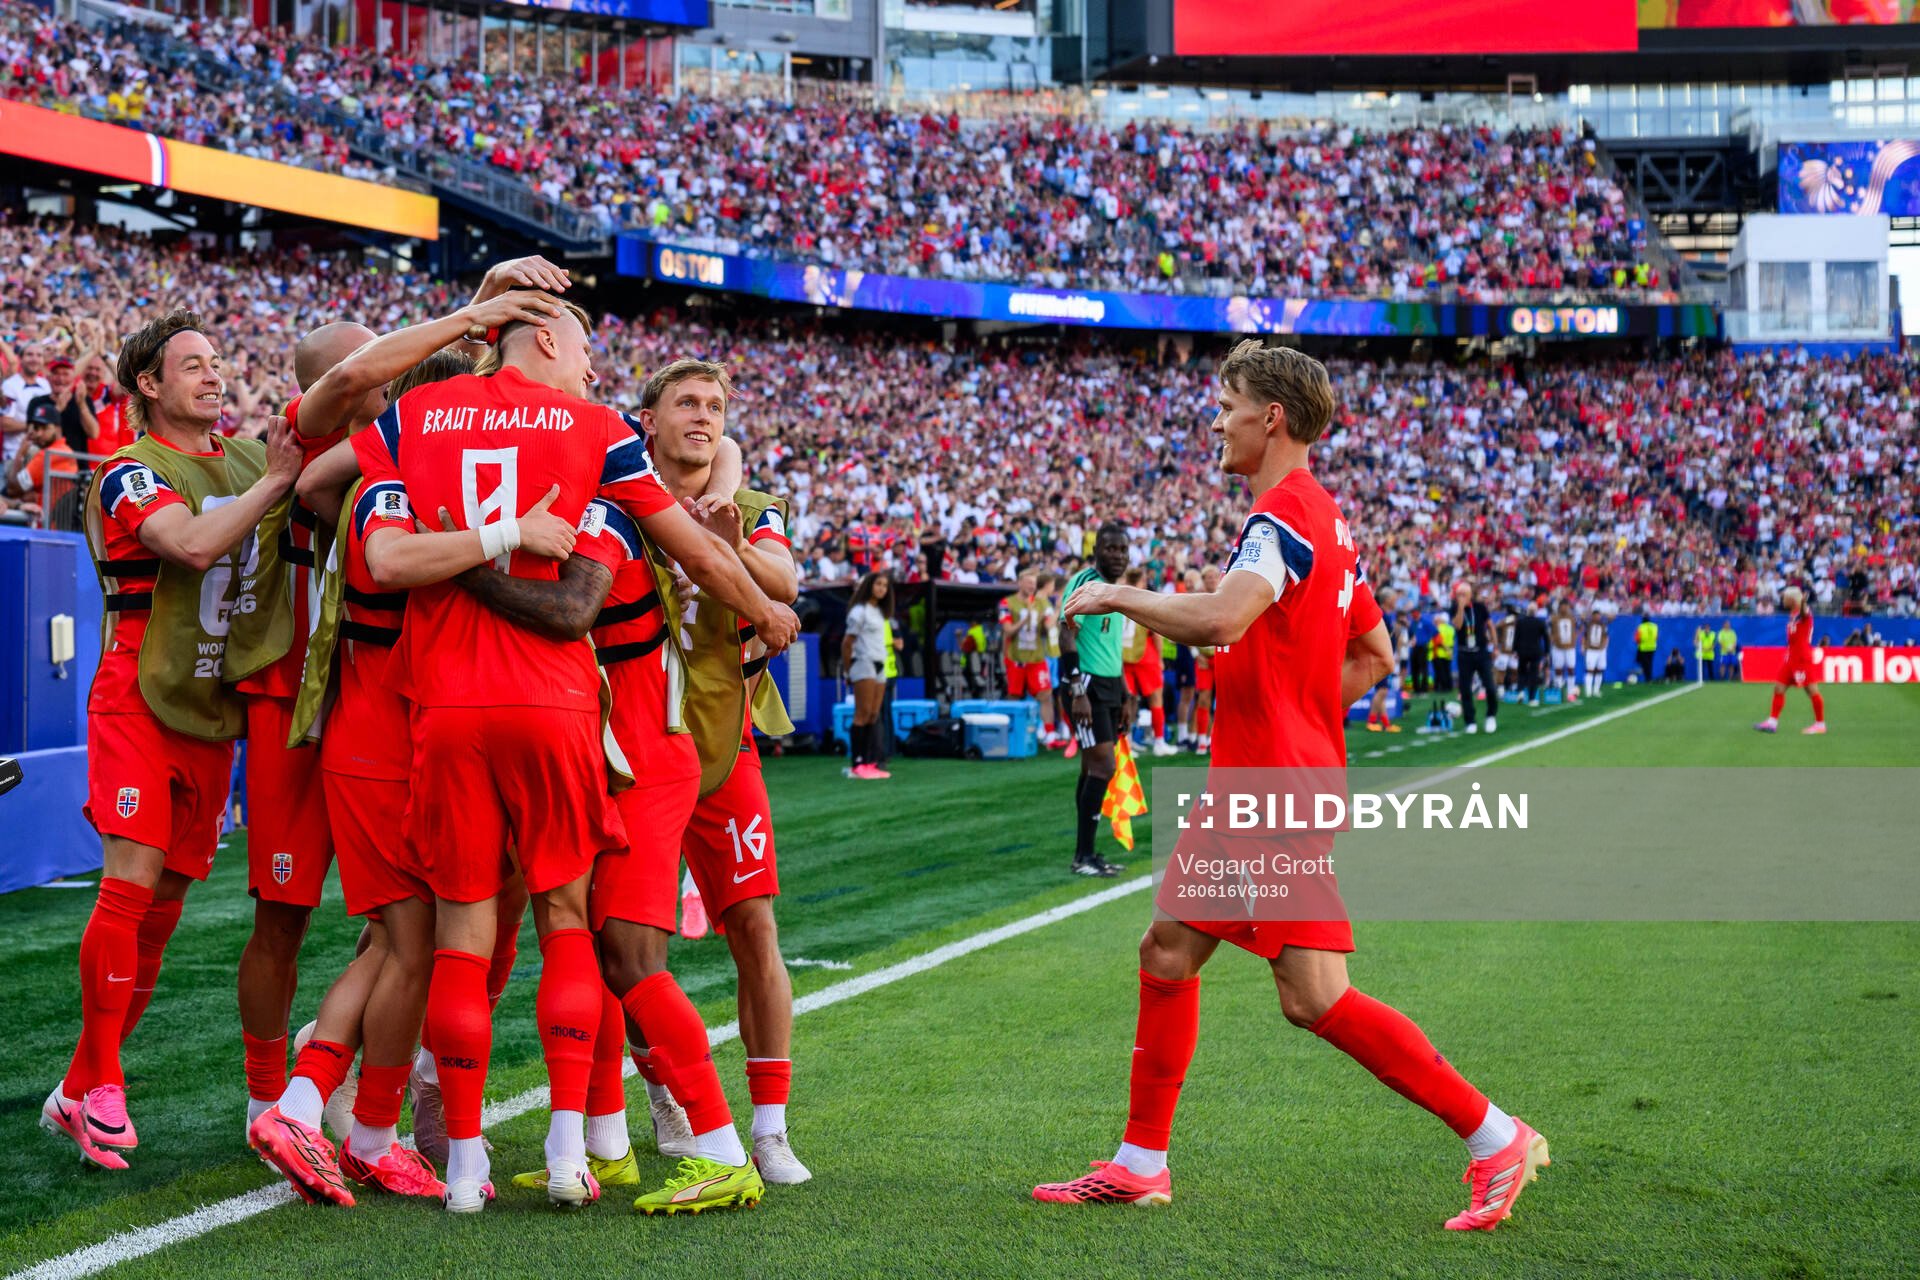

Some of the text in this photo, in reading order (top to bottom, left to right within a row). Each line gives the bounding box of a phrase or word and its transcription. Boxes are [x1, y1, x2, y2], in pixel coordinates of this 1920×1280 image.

[660, 248, 724, 285] OSTON
[1512, 307, 1618, 333] OSTON
[422, 407, 574, 435] BRAUT HAALAND
[461, 446, 519, 576] 9
[1812, 647, 1864, 683] 'm
[725, 813, 767, 863] 16
